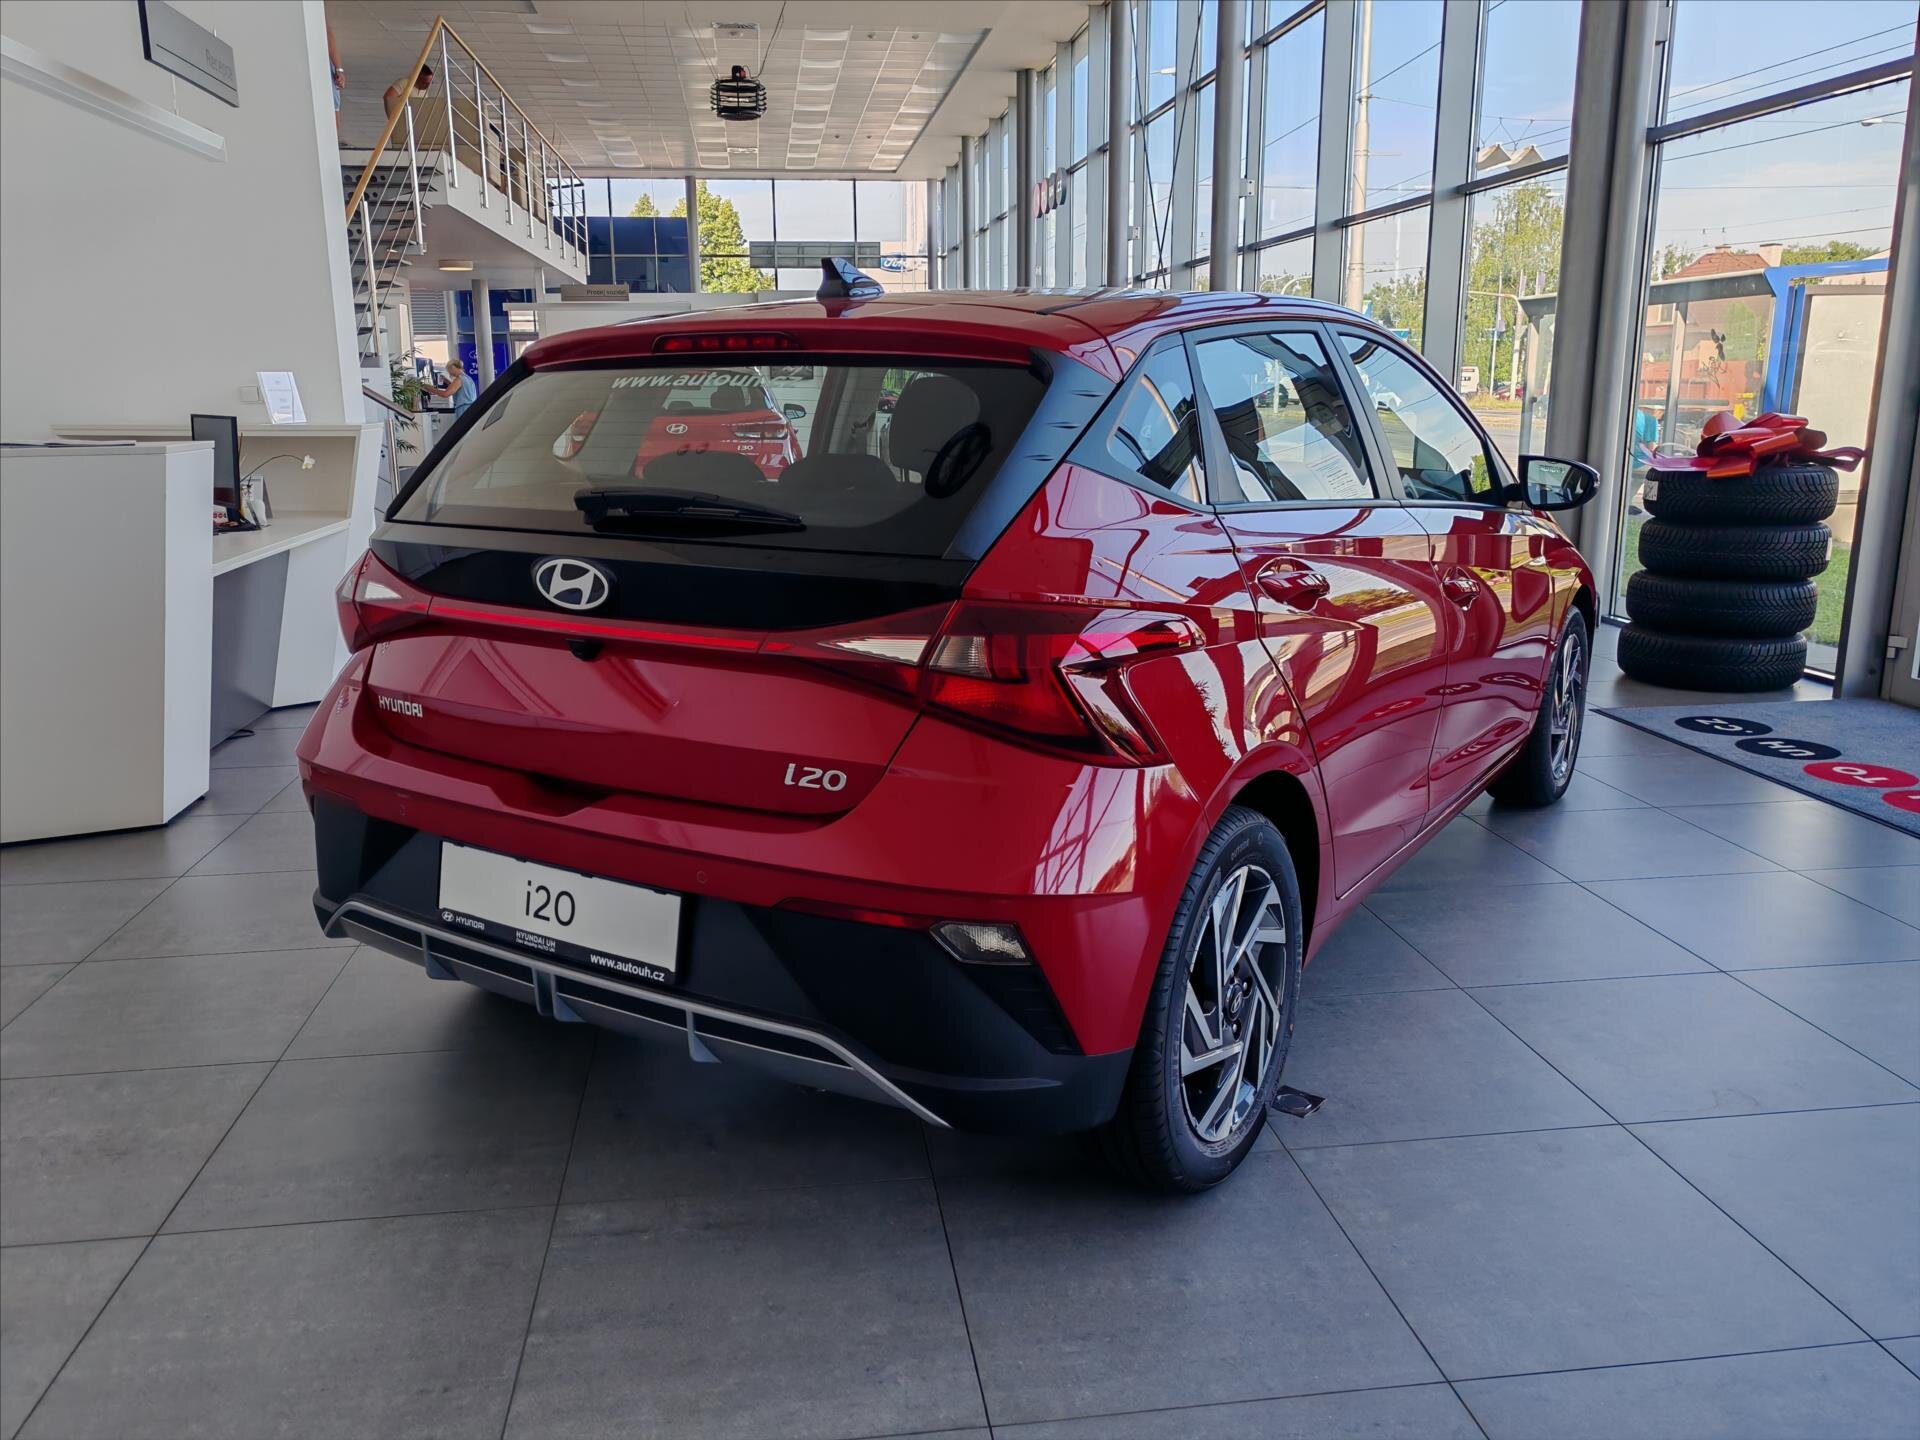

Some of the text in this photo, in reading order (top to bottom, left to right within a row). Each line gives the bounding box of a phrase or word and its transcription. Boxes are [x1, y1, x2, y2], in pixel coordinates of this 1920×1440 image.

[378, 695, 423, 718] HYUNDAI
[1757, 740, 1816, 758] UH
[784, 762, 847, 792] i20
[1831, 765, 1889, 784] TO
[526, 879, 576, 927] i20
[455, 916, 485, 931] HYUNDAI
[516, 930, 545, 945] HYUNDAI
[546, 938, 556, 948] UH
[590, 953, 665, 982] www.autouh.cz
